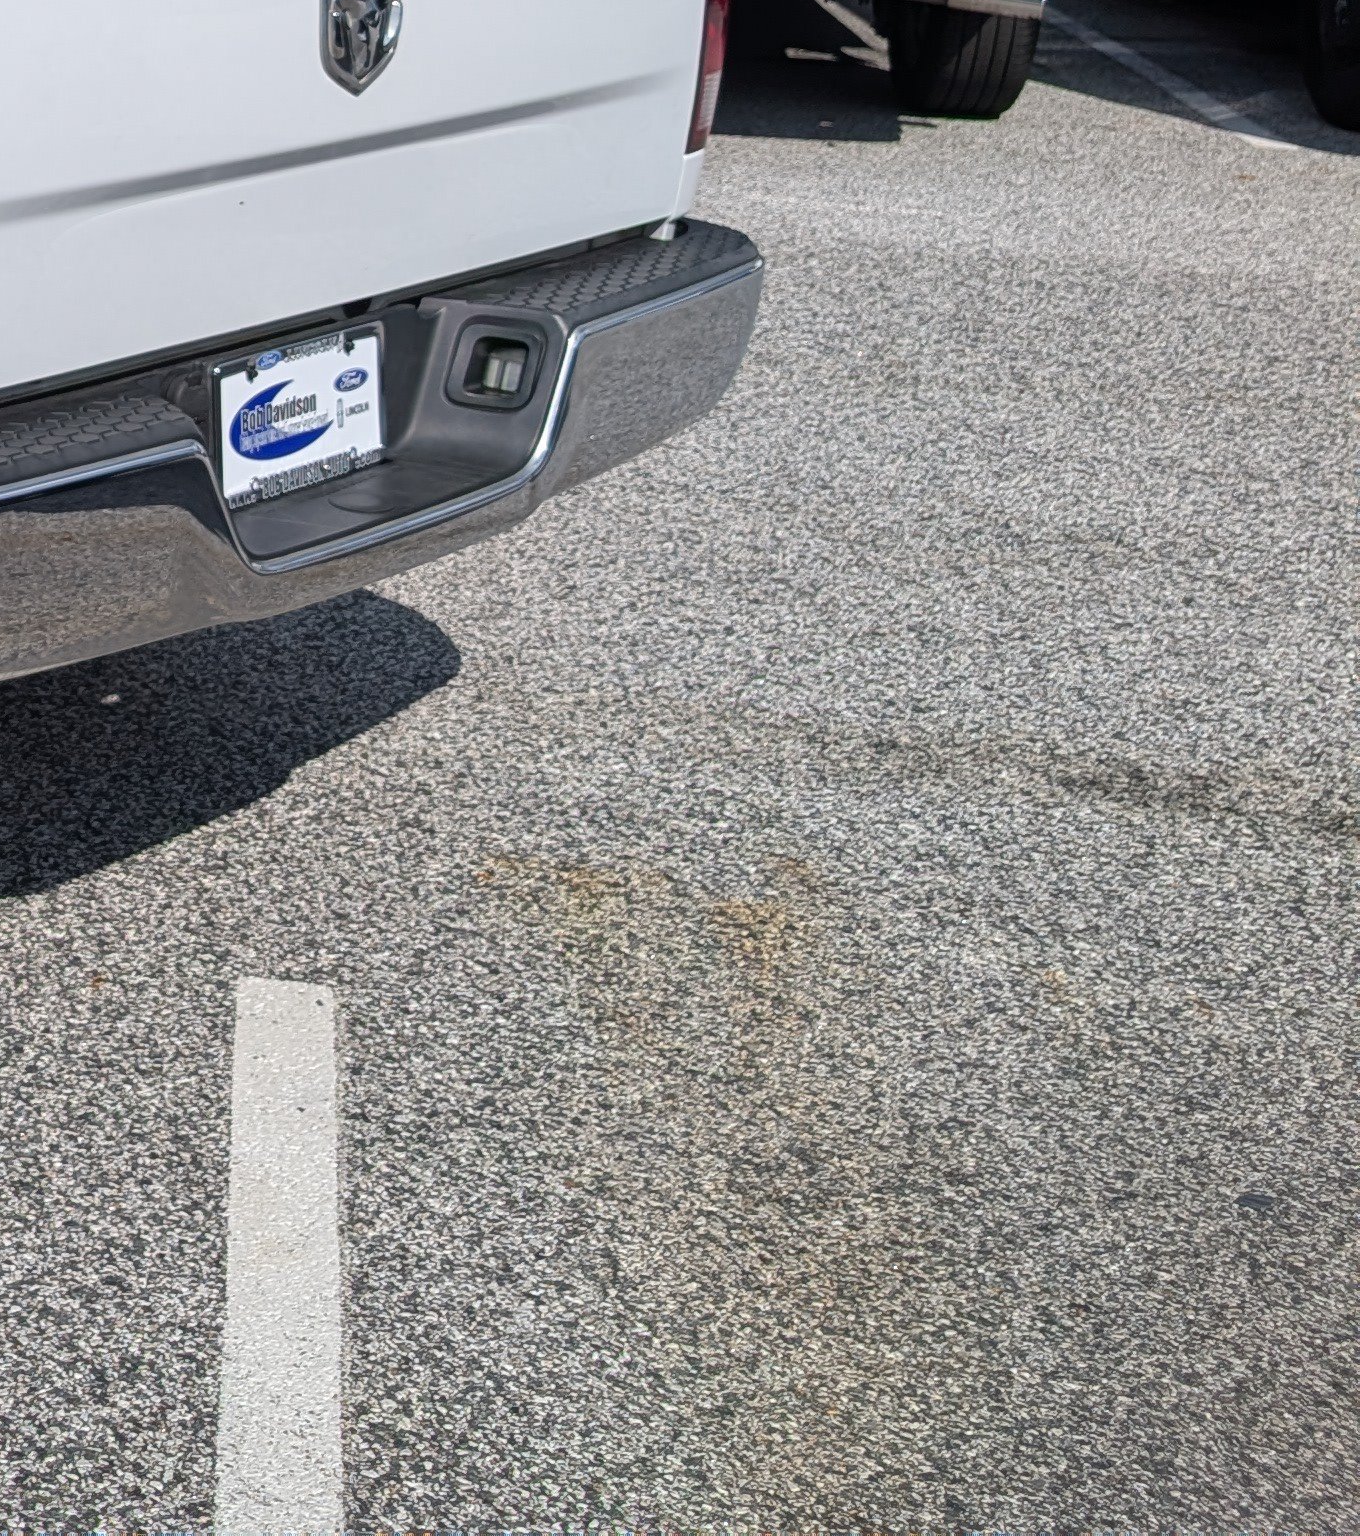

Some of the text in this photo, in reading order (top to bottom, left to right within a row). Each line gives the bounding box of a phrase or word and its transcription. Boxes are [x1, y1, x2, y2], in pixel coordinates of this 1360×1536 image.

[241, 405, 265, 433] Bob
[264, 394, 317, 425] Davidson
[345, 401, 370, 417] LINCOLN
